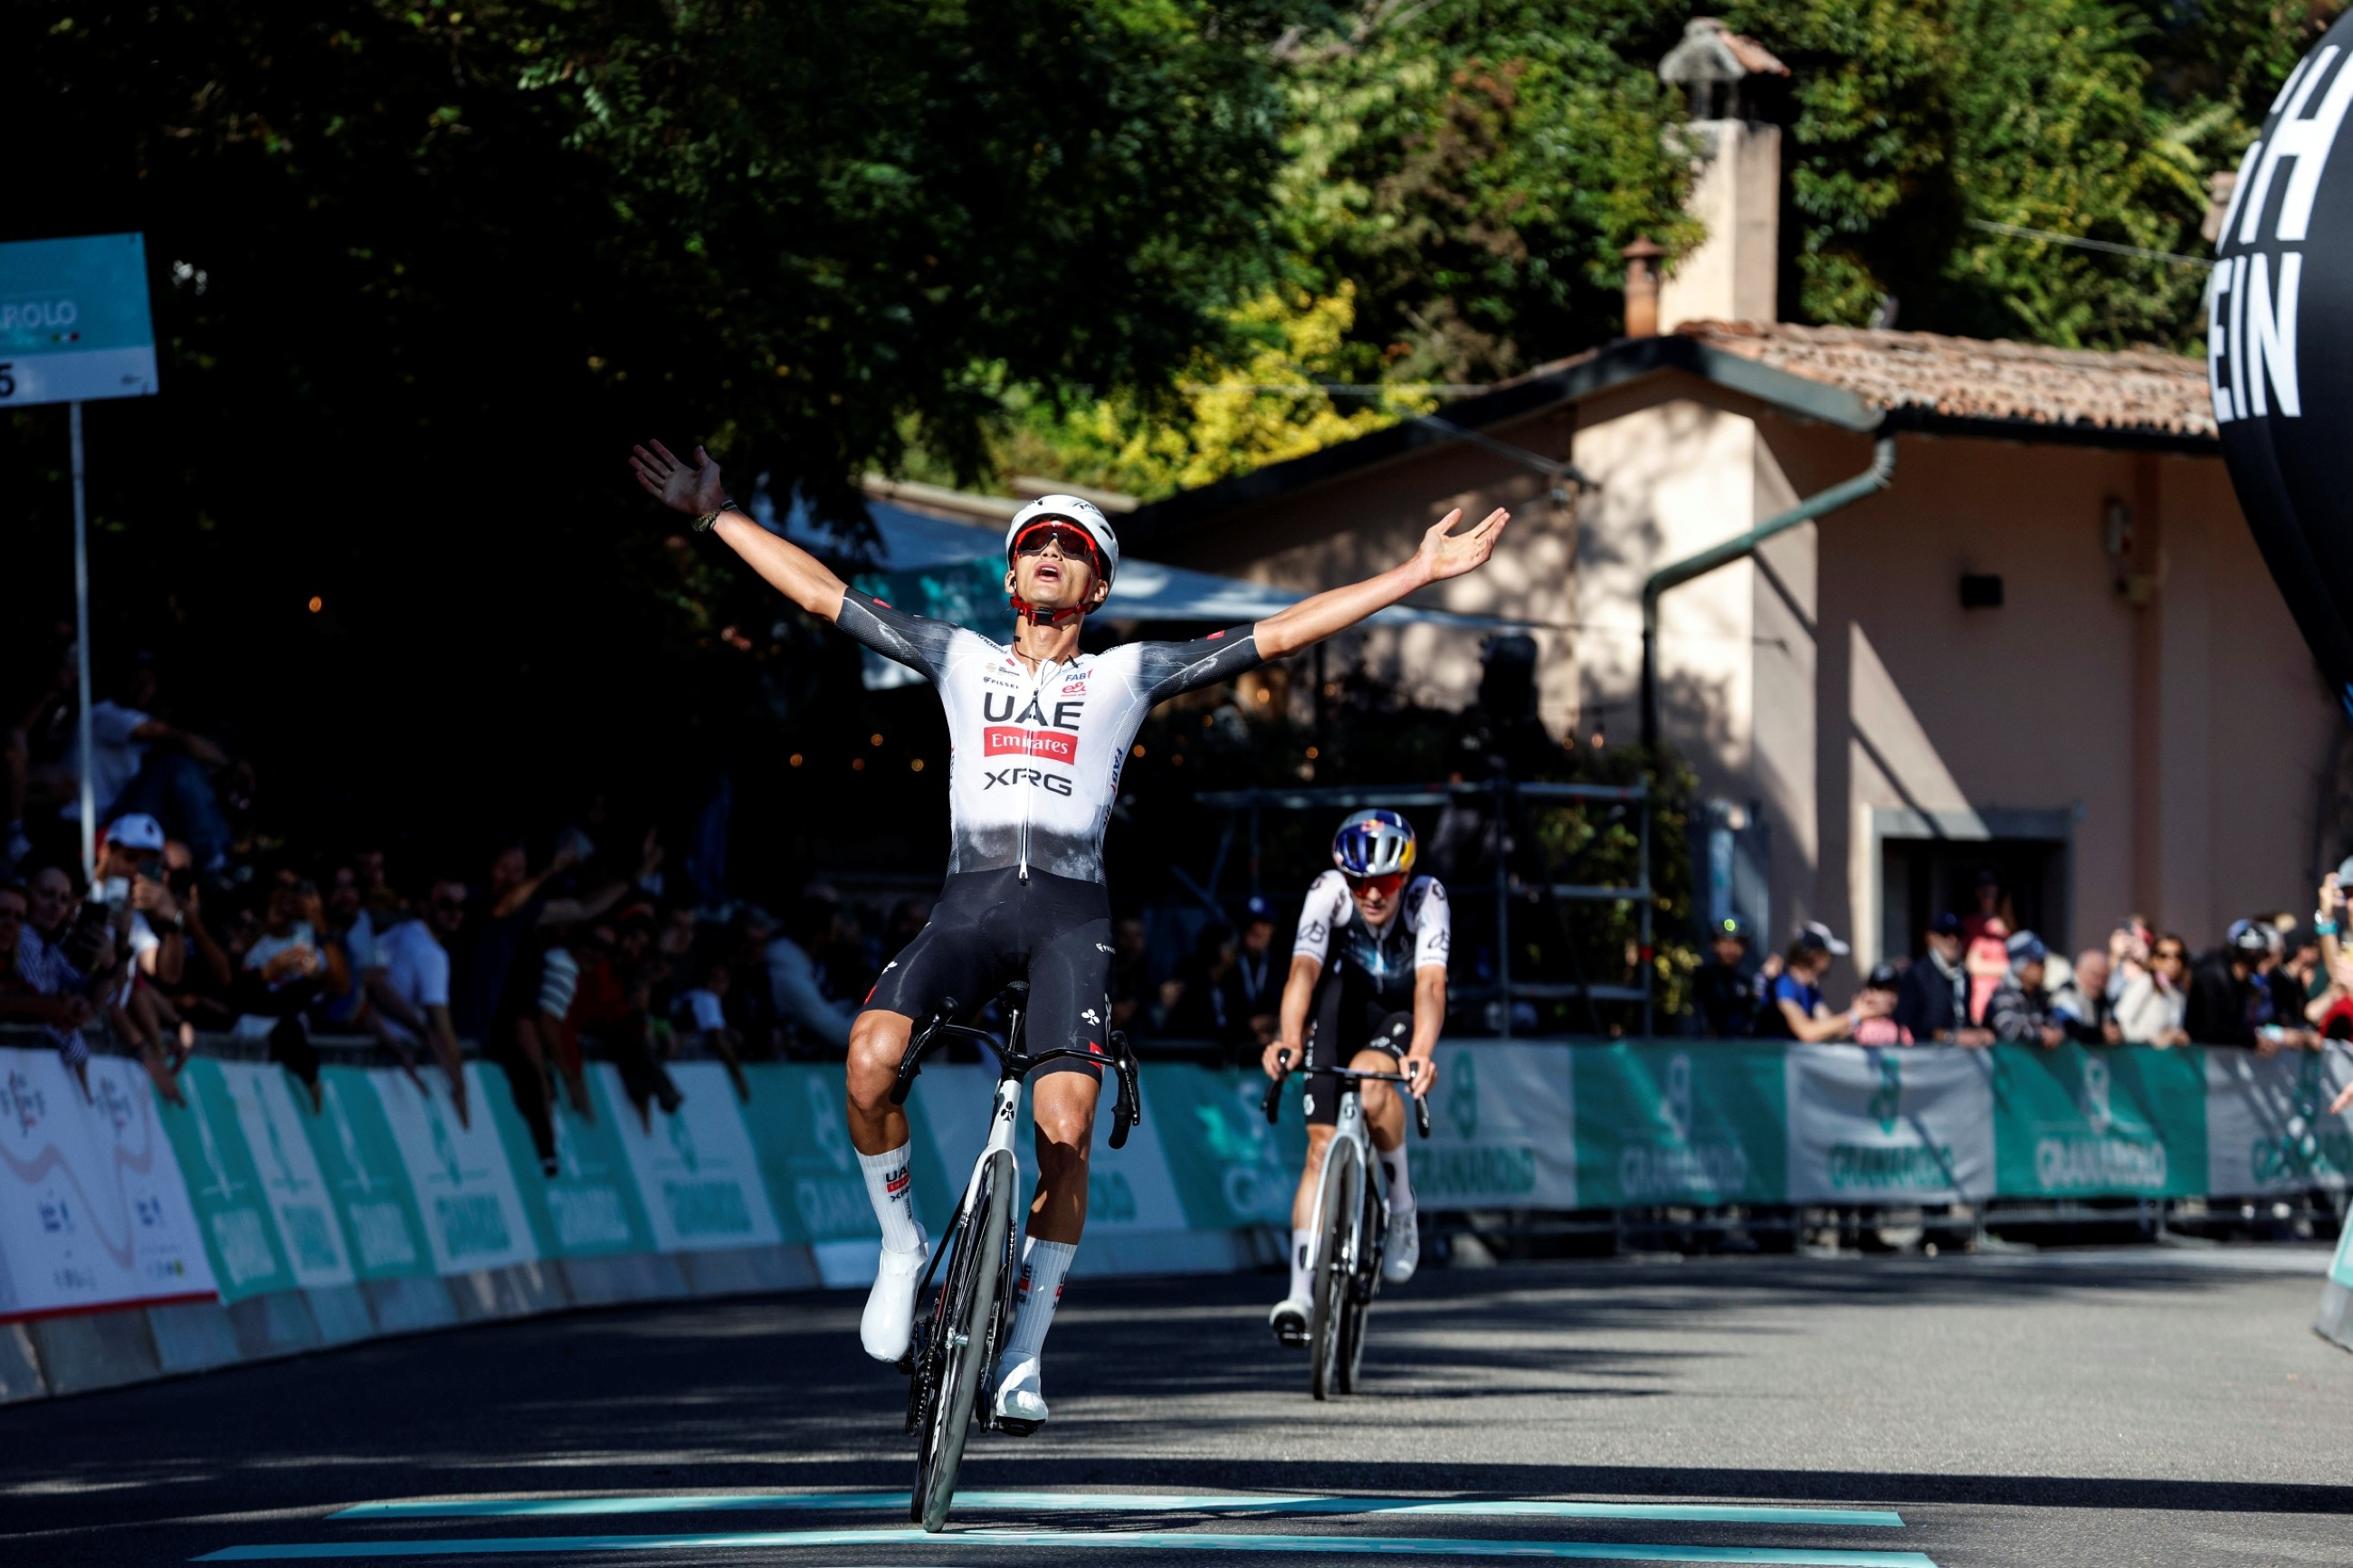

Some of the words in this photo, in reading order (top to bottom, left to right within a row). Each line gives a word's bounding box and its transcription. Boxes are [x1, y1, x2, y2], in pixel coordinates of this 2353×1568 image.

[2217, 43, 2353, 255] H
[0, 300, 77, 329] ROLO
[1065, 672, 1087, 682] FAB
[983, 692, 1085, 731] UAE
[992, 733, 1069, 755] Emirates
[983, 767, 1072, 797] XRG
